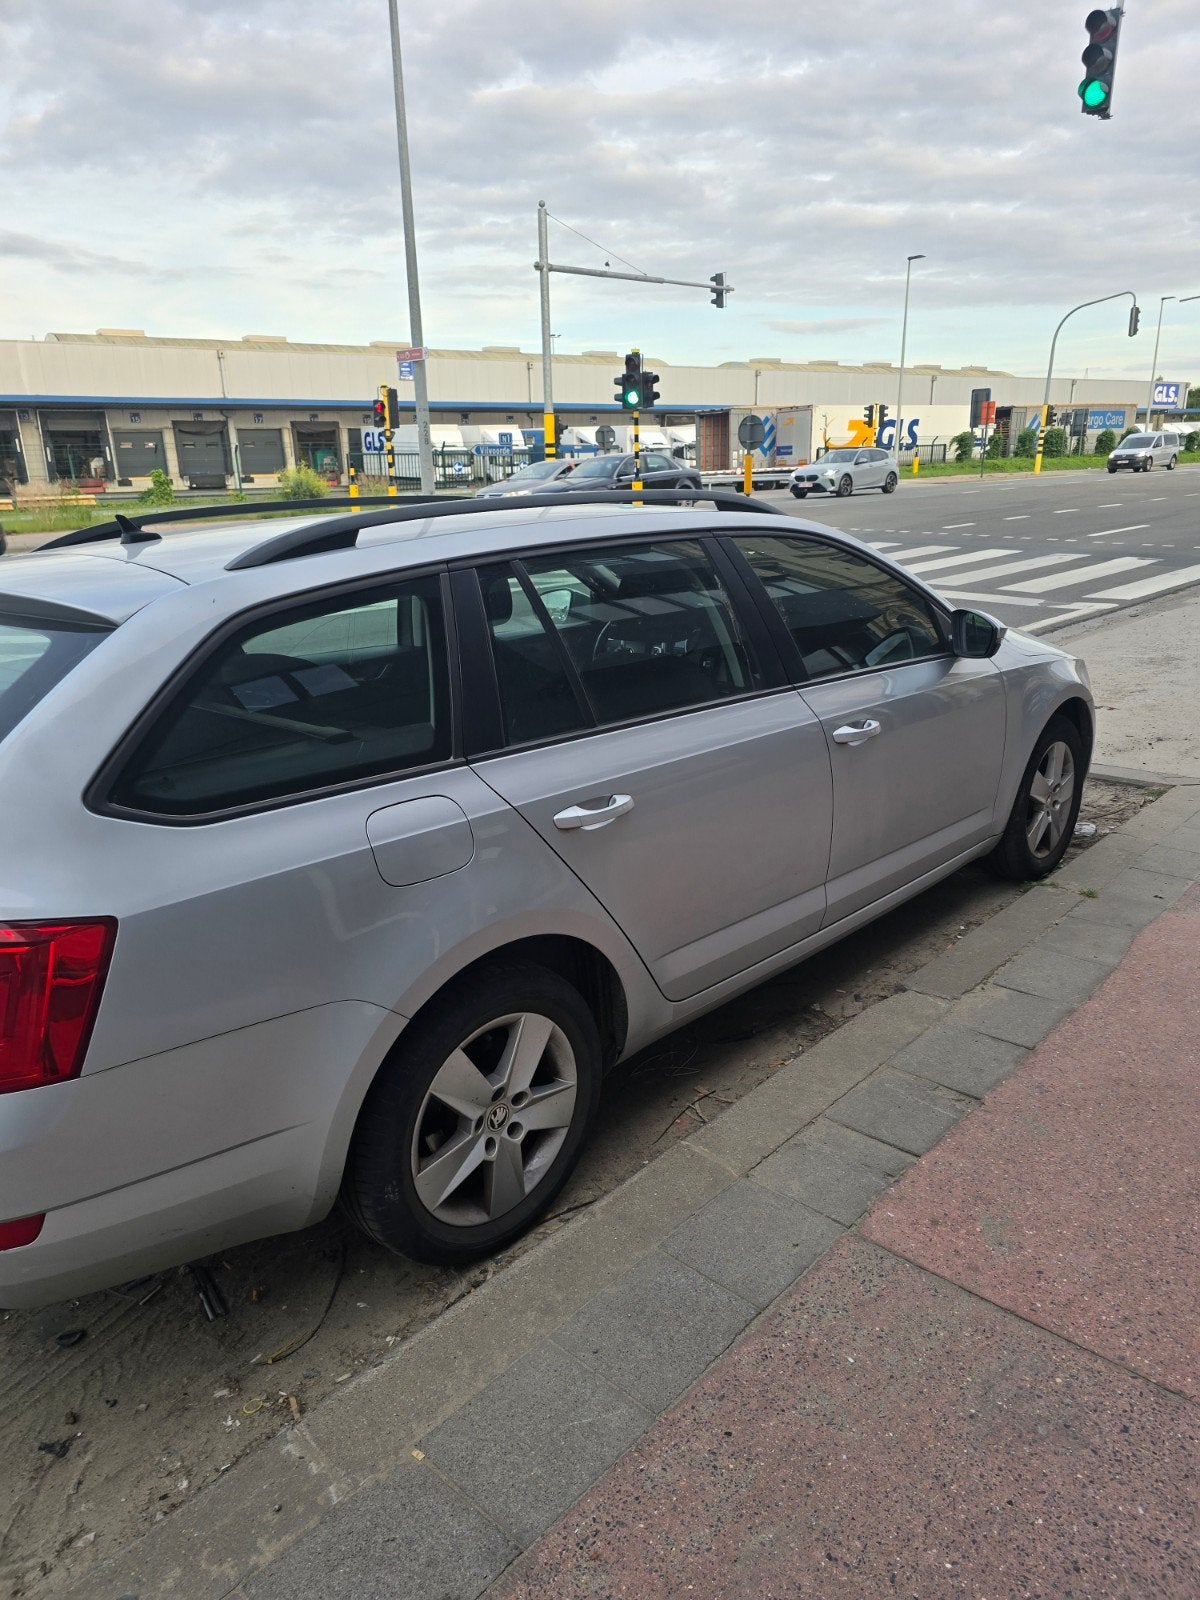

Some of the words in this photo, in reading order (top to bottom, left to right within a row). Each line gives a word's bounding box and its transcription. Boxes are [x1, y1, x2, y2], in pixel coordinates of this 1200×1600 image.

[1105, 412, 1124, 425] Care
[364, 431, 384, 451] GLS
[502, 434, 511, 443] N1
[480, 446, 511, 455] Vilvoorde
